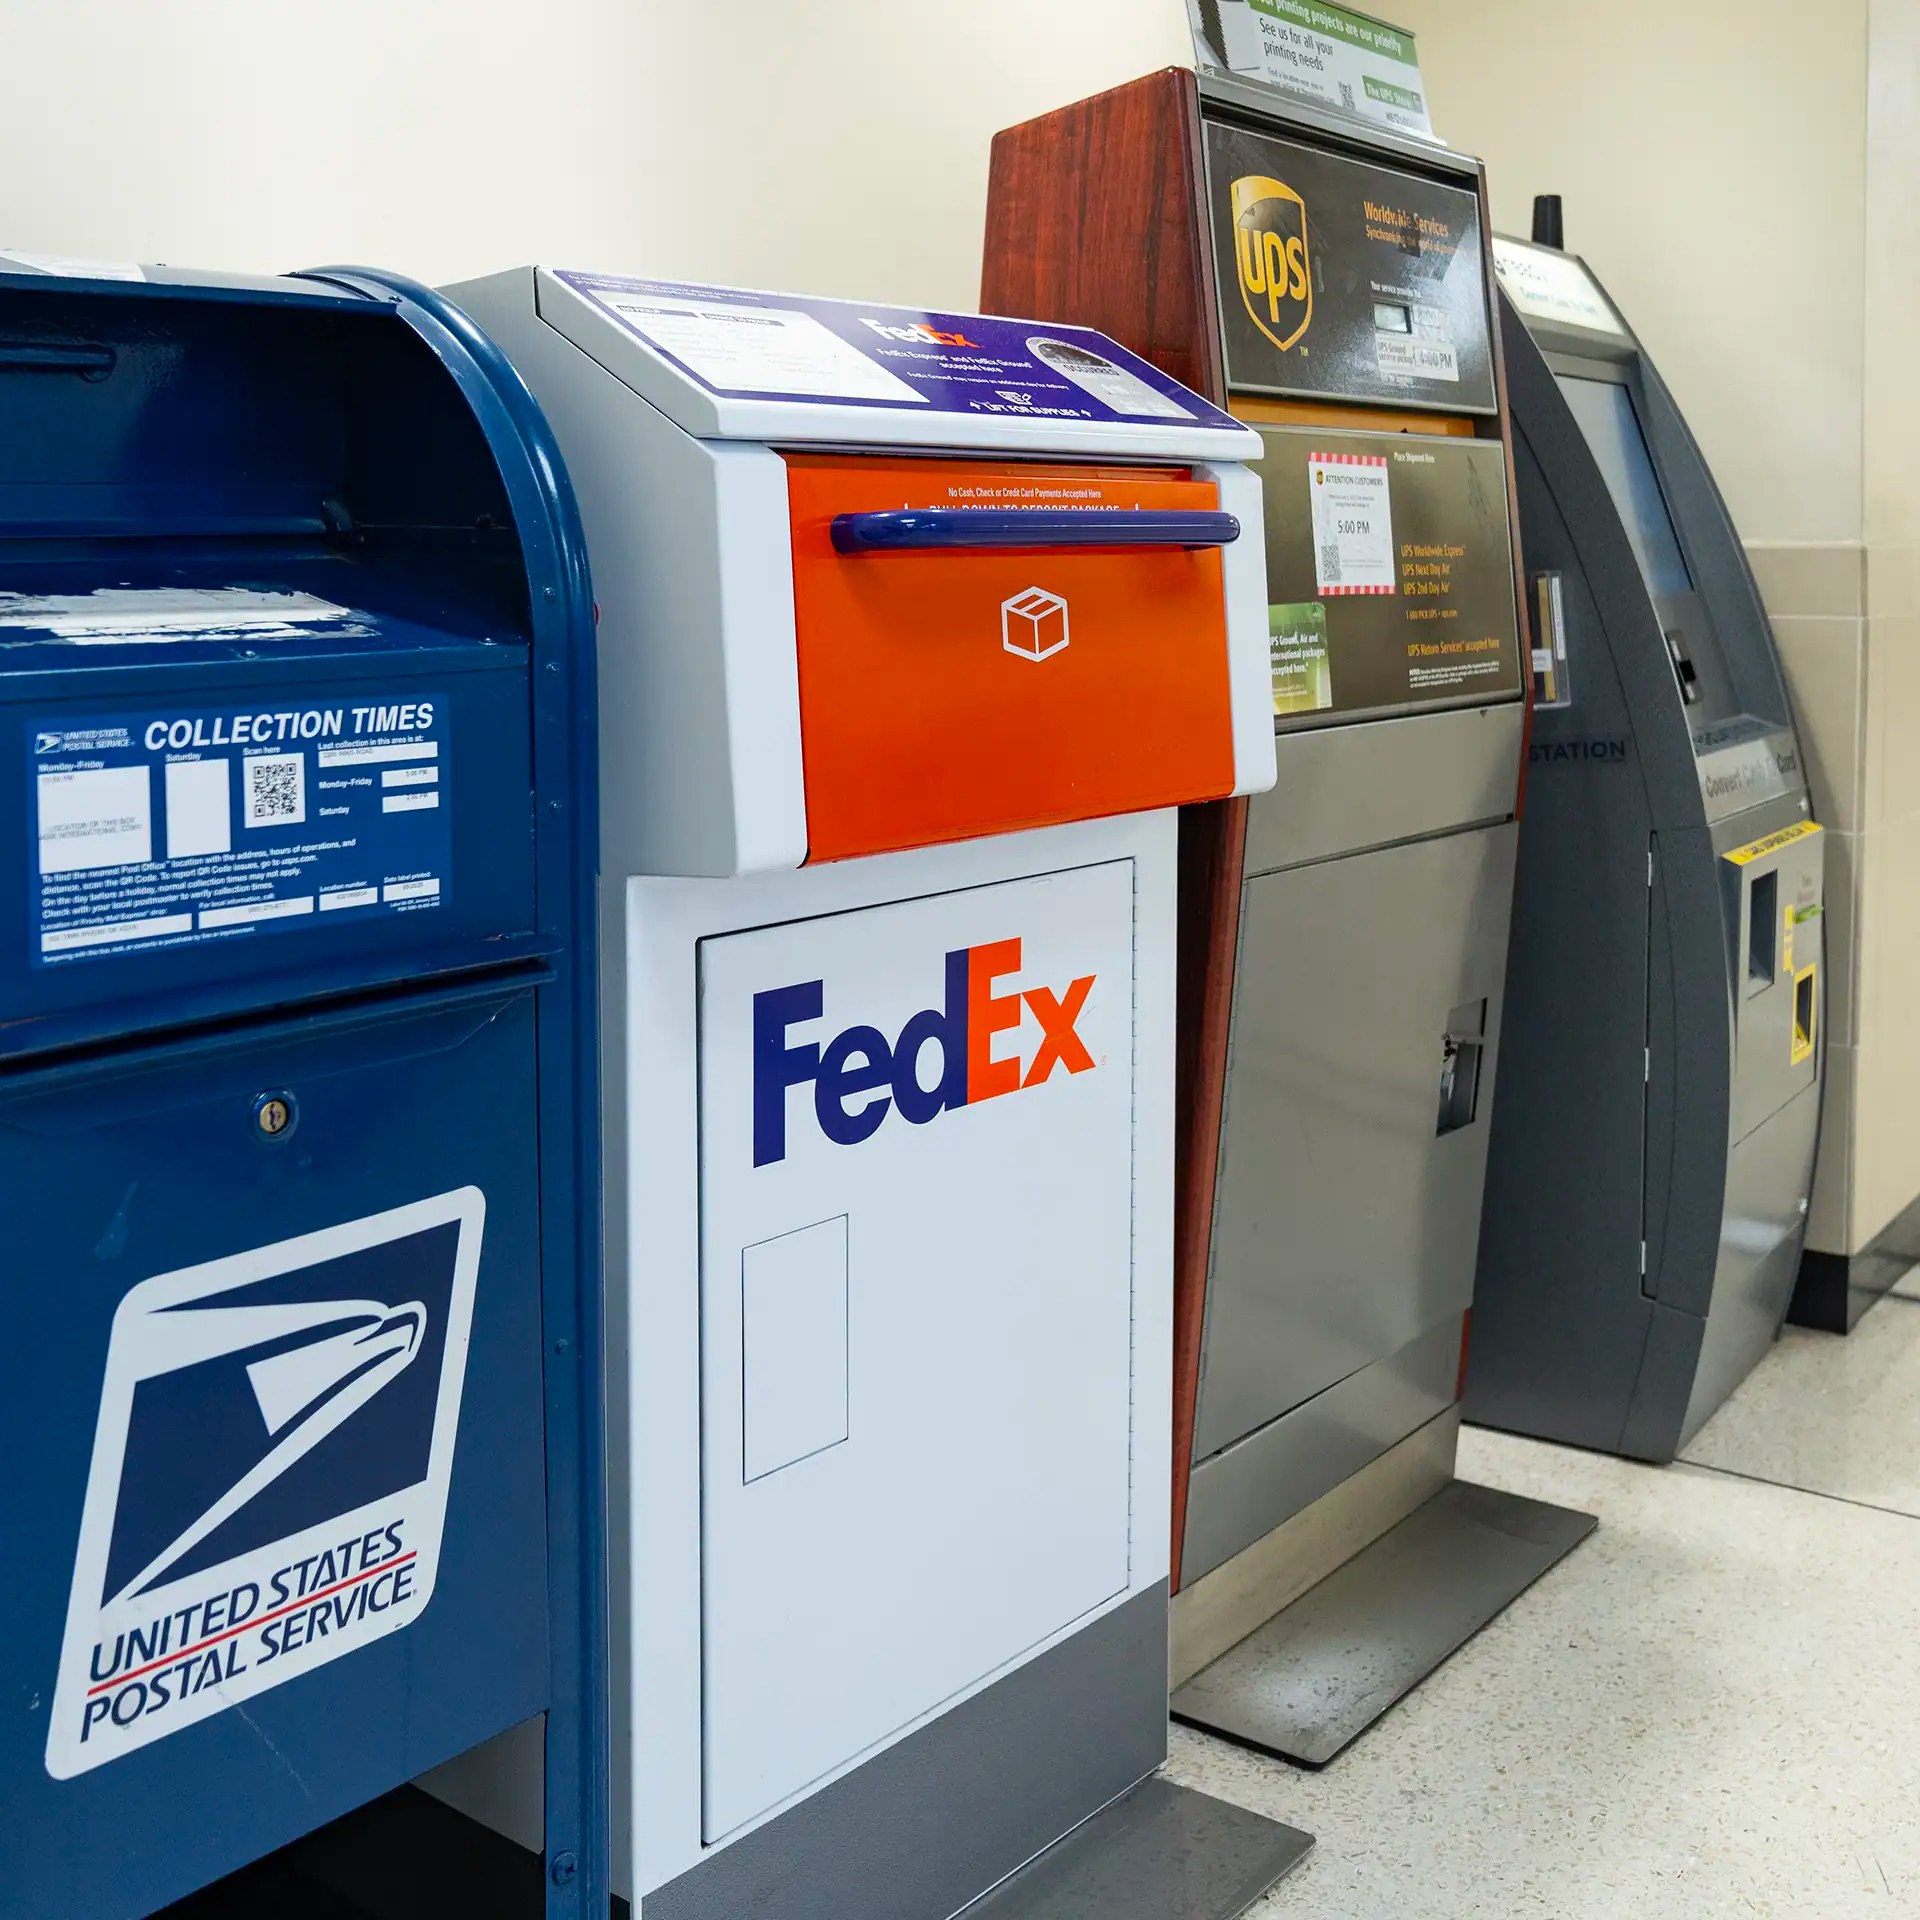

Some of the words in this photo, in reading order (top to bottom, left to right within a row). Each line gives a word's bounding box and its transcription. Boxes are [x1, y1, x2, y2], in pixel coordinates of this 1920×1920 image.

[1259, 17, 1276, 37] See
[1278, 28, 1288, 40] us
[1290, 27, 1301, 44] for
[1304, 34, 1314, 49] all
[1315, 40, 1333, 56] your
[1276, 0, 1310, 24] printing
[1311, 10, 1344, 31] projects
[1345, 23, 1358, 36] are
[1360, 28, 1372, 42] our
[1373, 32, 1401, 56] priority
[1264, 41, 1298, 67] printing
[1299, 52, 1324, 71] needs
[1366, 83, 1379, 97] The
[1380, 86, 1393, 101] UPS
[1364, 200, 1412, 228] Worldwide
[1413, 212, 1449, 237] Services
[1381, 284, 1396, 293] service
[859, 318, 982, 348] FedEx
[876, 348, 908, 358] FedEx
[907, 351, 947, 361] Express
[951, 356, 967, 364] and
[967, 356, 999, 366] FedEx
[998, 358, 1032, 368] Ground
[1440, 354, 1453, 368] PM
[939, 362, 979, 372] accepted
[979, 365, 1003, 373] here
[1063, 364, 1120, 377] OCCURRED
[985, 402, 1008, 412] LIFT
[1007, 404, 1030, 414] FOR
[1029, 406, 1080, 417] SUPPLIES
[1326, 475, 1354, 485] ATTENTION
[1355, 477, 1384, 486] CUSTOMERS
[948, 487, 957, 497] No
[959, 487, 975, 498] Cash,
[976, 488, 995, 497] Check
[1003, 488, 1020, 497] Credit
[1020, 488, 1034, 497] Card
[1035, 488, 1061, 499] Payments
[1062, 489, 1088, 499] Accepted
[1088, 489, 1101, 498] Here
[1338, 520, 1355, 534] 5:00
[1357, 521, 1370, 534] PM
[1401, 544, 1413, 558] UPS
[1413, 544, 1443, 557] Worldwide
[1444, 543, 1464, 559] Express
[1402, 563, 1415, 576] UPS
[1415, 563, 1429, 576] Next
[1430, 563, 1441, 579] Day
[1442, 563, 1450, 575] Air
[1404, 582, 1416, 595] UPS
[1417, 581, 1428, 594] 2nd
[1429, 581, 1440, 597] Day
[1280, 631, 1299, 646] Ground,
[1300, 633, 1308, 643] Air
[1309, 632, 1318, 643] and
[1407, 644, 1420, 656] UPS
[1420, 643, 1440, 656] Return
[1440, 641, 1462, 654] Services
[1465, 638, 1487, 652] accepted
[1487, 637, 1500, 648] here
[1302, 648, 1325, 660] packages
[144, 709, 344, 750] COLLECTION
[352, 703, 434, 734] TIMES
[243, 747, 263, 756] Scan
[264, 746, 281, 755] here
[317, 742, 334, 750] Last
[335, 739, 368, 749] collection
[370, 738, 377, 746] in
[377, 737, 390, 745] this
[408, 735, 414, 743] is
[1529, 740, 1625, 762] STATION
[165, 753, 201, 763] Saturday
[1705, 767, 1742, 799] Convert
[1777, 749, 1796, 775] Card
[319, 806, 350, 817] Saturday
[42, 874, 53, 883] To
[54, 872, 71, 881] find
[72, 870, 87, 879] the
[88, 866, 119, 877] nearest
[120, 864, 139, 873] Post
[171, 856, 204, 867] location
[204, 854, 222, 863] with
[223, 852, 235, 861] the
[236, 848, 269, 860] address,
[269, 845, 291, 855] hours
[293, 844, 300, 852] of
[301, 839, 341, 852] operations,
[342, 838, 355, 846] and
[41, 882, 81, 896] distance,
[83, 879, 104, 889] scan
[105, 877, 118, 887] the
[120, 876, 133, 886] QR
[134, 872, 158, 883] Code.
[160, 871, 170, 879] To
[171, 868, 196, 879] report
[196, 866, 210, 876] QR
[211, 863, 232, 873] Code
[234, 860, 259, 871] issues,
[260, 859, 270, 868] go
[272, 857, 280, 865] to
[281, 853, 317, 865] usps.com.
[42, 897, 55, 908] On
[56, 895, 71, 906] the
[72, 893, 88, 905] day
[89, 889, 117, 901] before
[125, 884, 157, 898] holiday,
[158, 880, 186, 892] normal
[187, 875, 225, 888] collection
[226, 872, 247, 883] times
[248, 870, 264, 881] may
[266, 868, 278, 878] not
[280, 865, 301, 877] apply.
[319, 882, 344, 891] Location
[42, 907, 70, 918] Check
[72, 904, 89, 914] with
[91, 902, 111, 913] your
[112, 899, 132, 909] local
[133, 892, 180, 907] postmaster
[180, 891, 189, 900] to
[190, 888, 211, 899] verify
[213, 883, 250, 895] collection
[251, 880, 274, 890] times.
[753, 936, 1097, 1169] FedEx
[90, 1582, 259, 1682] UNITED
[267, 1519, 404, 1611] STATES
[80, 1640, 248, 1744] POSTAL
[257, 1562, 416, 1666] SERVICE
